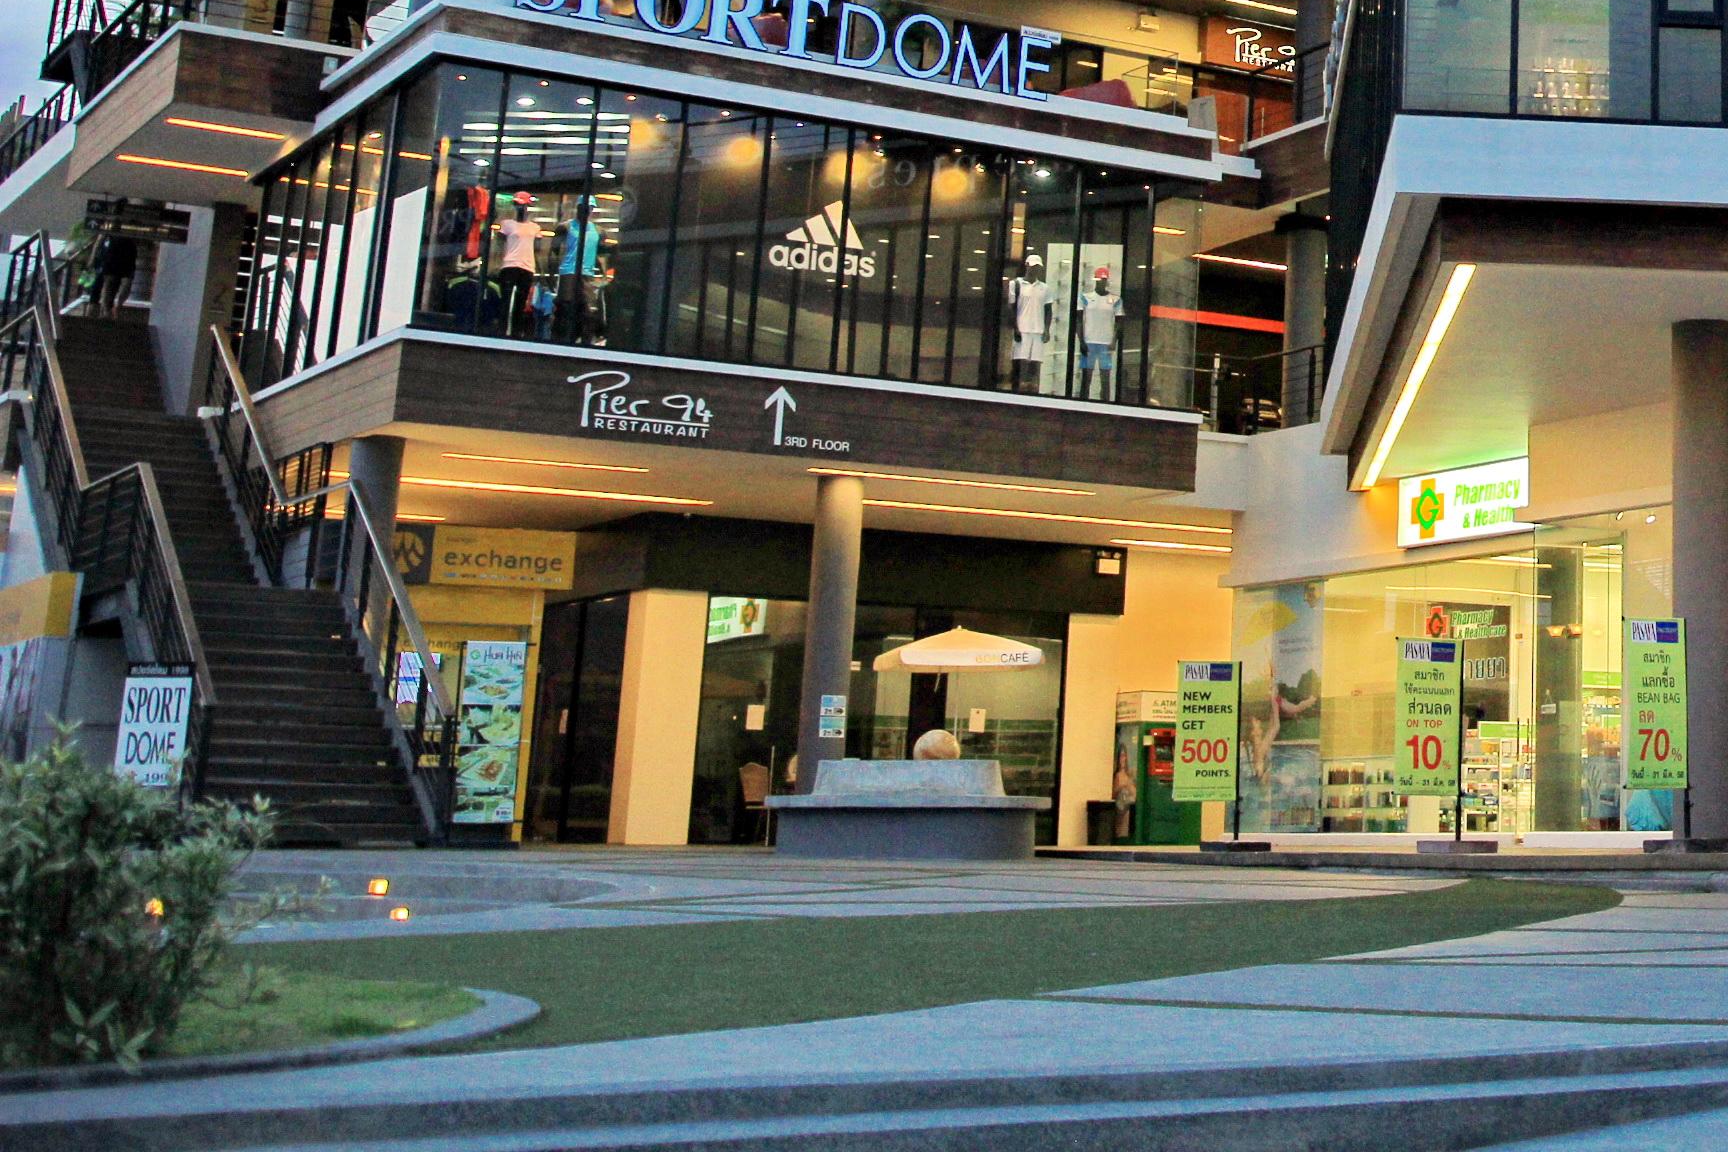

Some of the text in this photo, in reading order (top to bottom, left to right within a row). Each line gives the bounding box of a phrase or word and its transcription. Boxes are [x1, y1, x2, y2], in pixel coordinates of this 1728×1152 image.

[1226, 28, 1273, 63] Pier
[768, 242, 876, 278] adidas
[567, 370, 714, 428] Pier 94
[594, 417, 710, 439] RESTAURANT
[784, 436, 850, 453] 3RD FLOOR
[1453, 478, 1521, 507] Pharmacy
[1463, 513, 1471, 529] &
[444, 550, 563, 575] exchange
[1451, 609, 1494, 628] Pharmacy
[125, 686, 186, 724] SPORT
[1183, 691, 1212, 701] NEW
[1637, 693, 1681, 704] BEAN BAG
[1182, 704, 1233, 714] MEMBERS
[1408, 698, 1452, 715] ส่วนลด
[1182, 720, 1206, 730] GET
[1406, 720, 1443, 729] ON TOP
[124, 731, 177, 765] DOME
